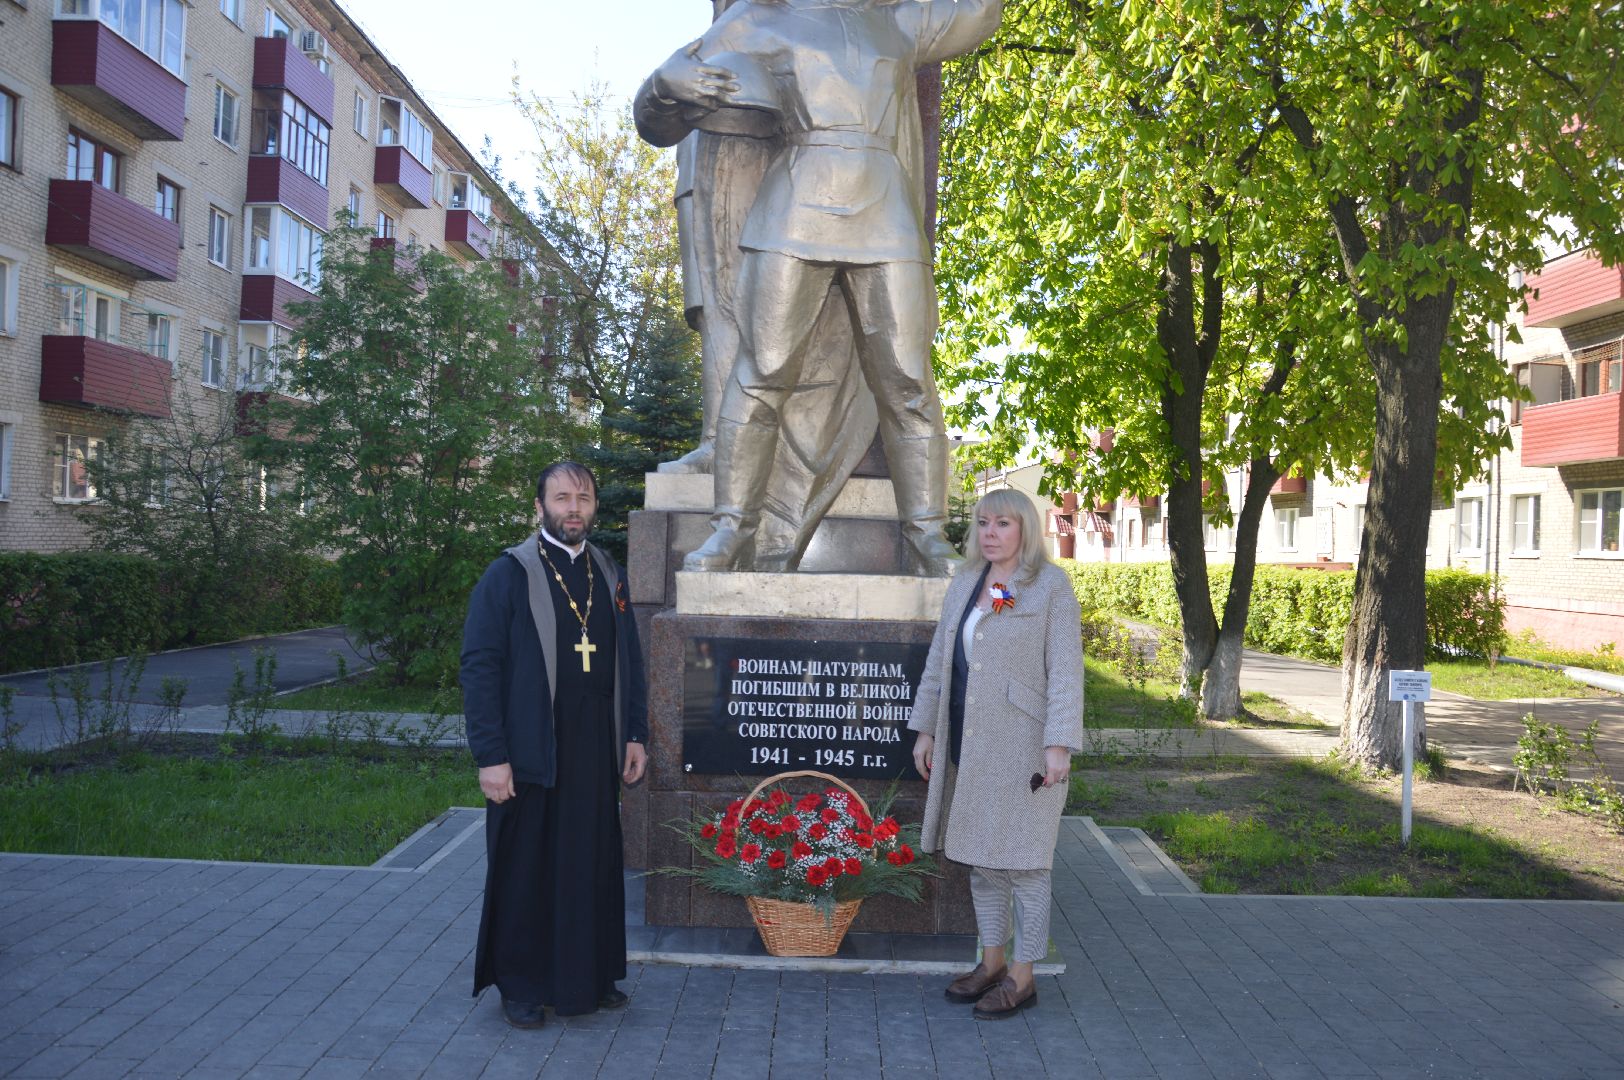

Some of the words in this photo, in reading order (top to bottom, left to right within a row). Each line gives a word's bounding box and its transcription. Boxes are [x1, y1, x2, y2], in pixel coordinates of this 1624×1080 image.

[738, 658, 906, 680] ВОИНАМ-ШАТУРЯНАМ,
[732, 680, 820, 697] ПОГИБШИМ
[826, 683, 835, 697] В
[840, 682, 911, 700] ВЕЛИКОЙ
[727, 701, 857, 719] ОТЕЧЕСТВЕННОЙ
[738, 722, 837, 739] СОВЕТСКОГО
[842, 726, 901, 743] НАРОДА
[750, 747, 790, 764] 1941
[814, 749, 855, 766] 1945
[862, 755, 888, 767] г.г.
